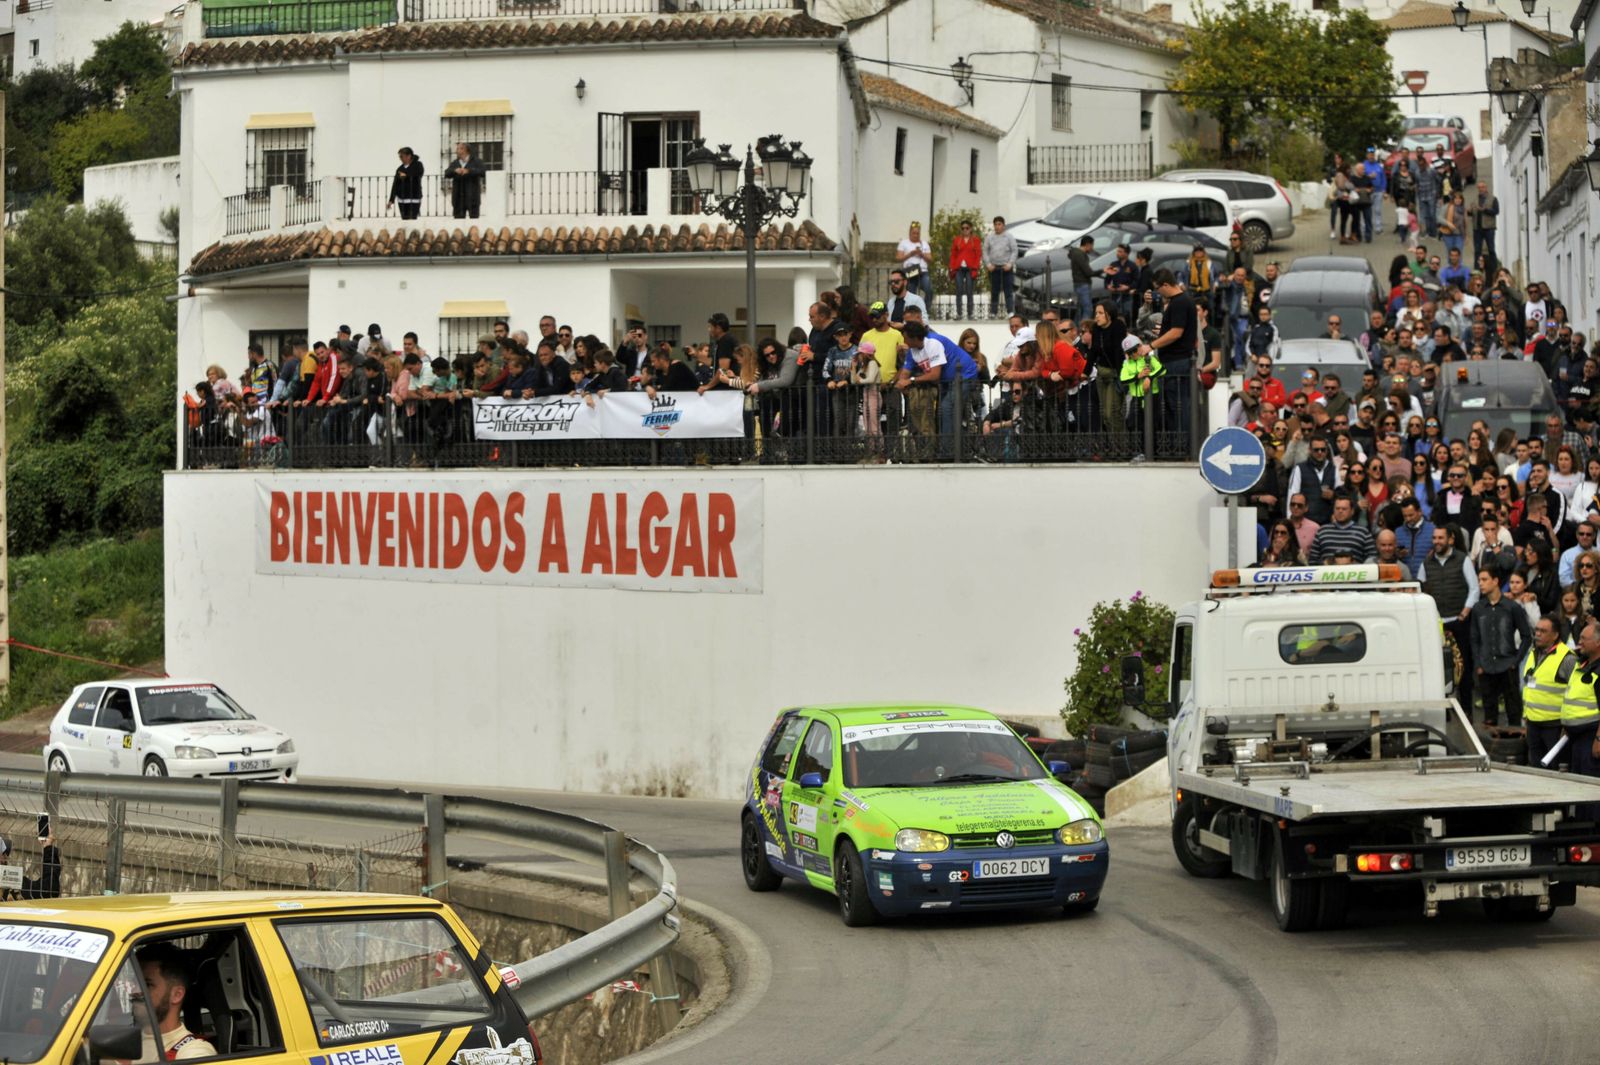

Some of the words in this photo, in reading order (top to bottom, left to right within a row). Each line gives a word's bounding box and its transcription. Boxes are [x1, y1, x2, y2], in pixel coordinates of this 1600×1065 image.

[476, 399, 580, 423] BUZRÓN
[645, 413, 679, 425] FERMA
[270, 491, 526, 573] BIENVENIDOS
[538, 493, 569, 573] A
[581, 491, 738, 578] ALGAR
[1253, 569, 1318, 583] GRUAS
[1321, 570, 1368, 582] MAPE
[863, 726, 894, 736] TT
[902, 722, 991, 731] CAMPER
[123, 735, 132, 748] 42
[240, 760, 259, 770] 5052
[956, 817, 1045, 832] telegerena@telegerena.es
[1457, 849, 1495, 864] 9559
[1500, 847, 1527, 862] GGJ
[982, 861, 1017, 876] 0062
[1021, 860, 1046, 874] DCY
[329, 1023, 355, 1039] CARLOS
[355, 1020, 380, 1036] CRESPO
[336, 1044, 400, 1065] REALE
